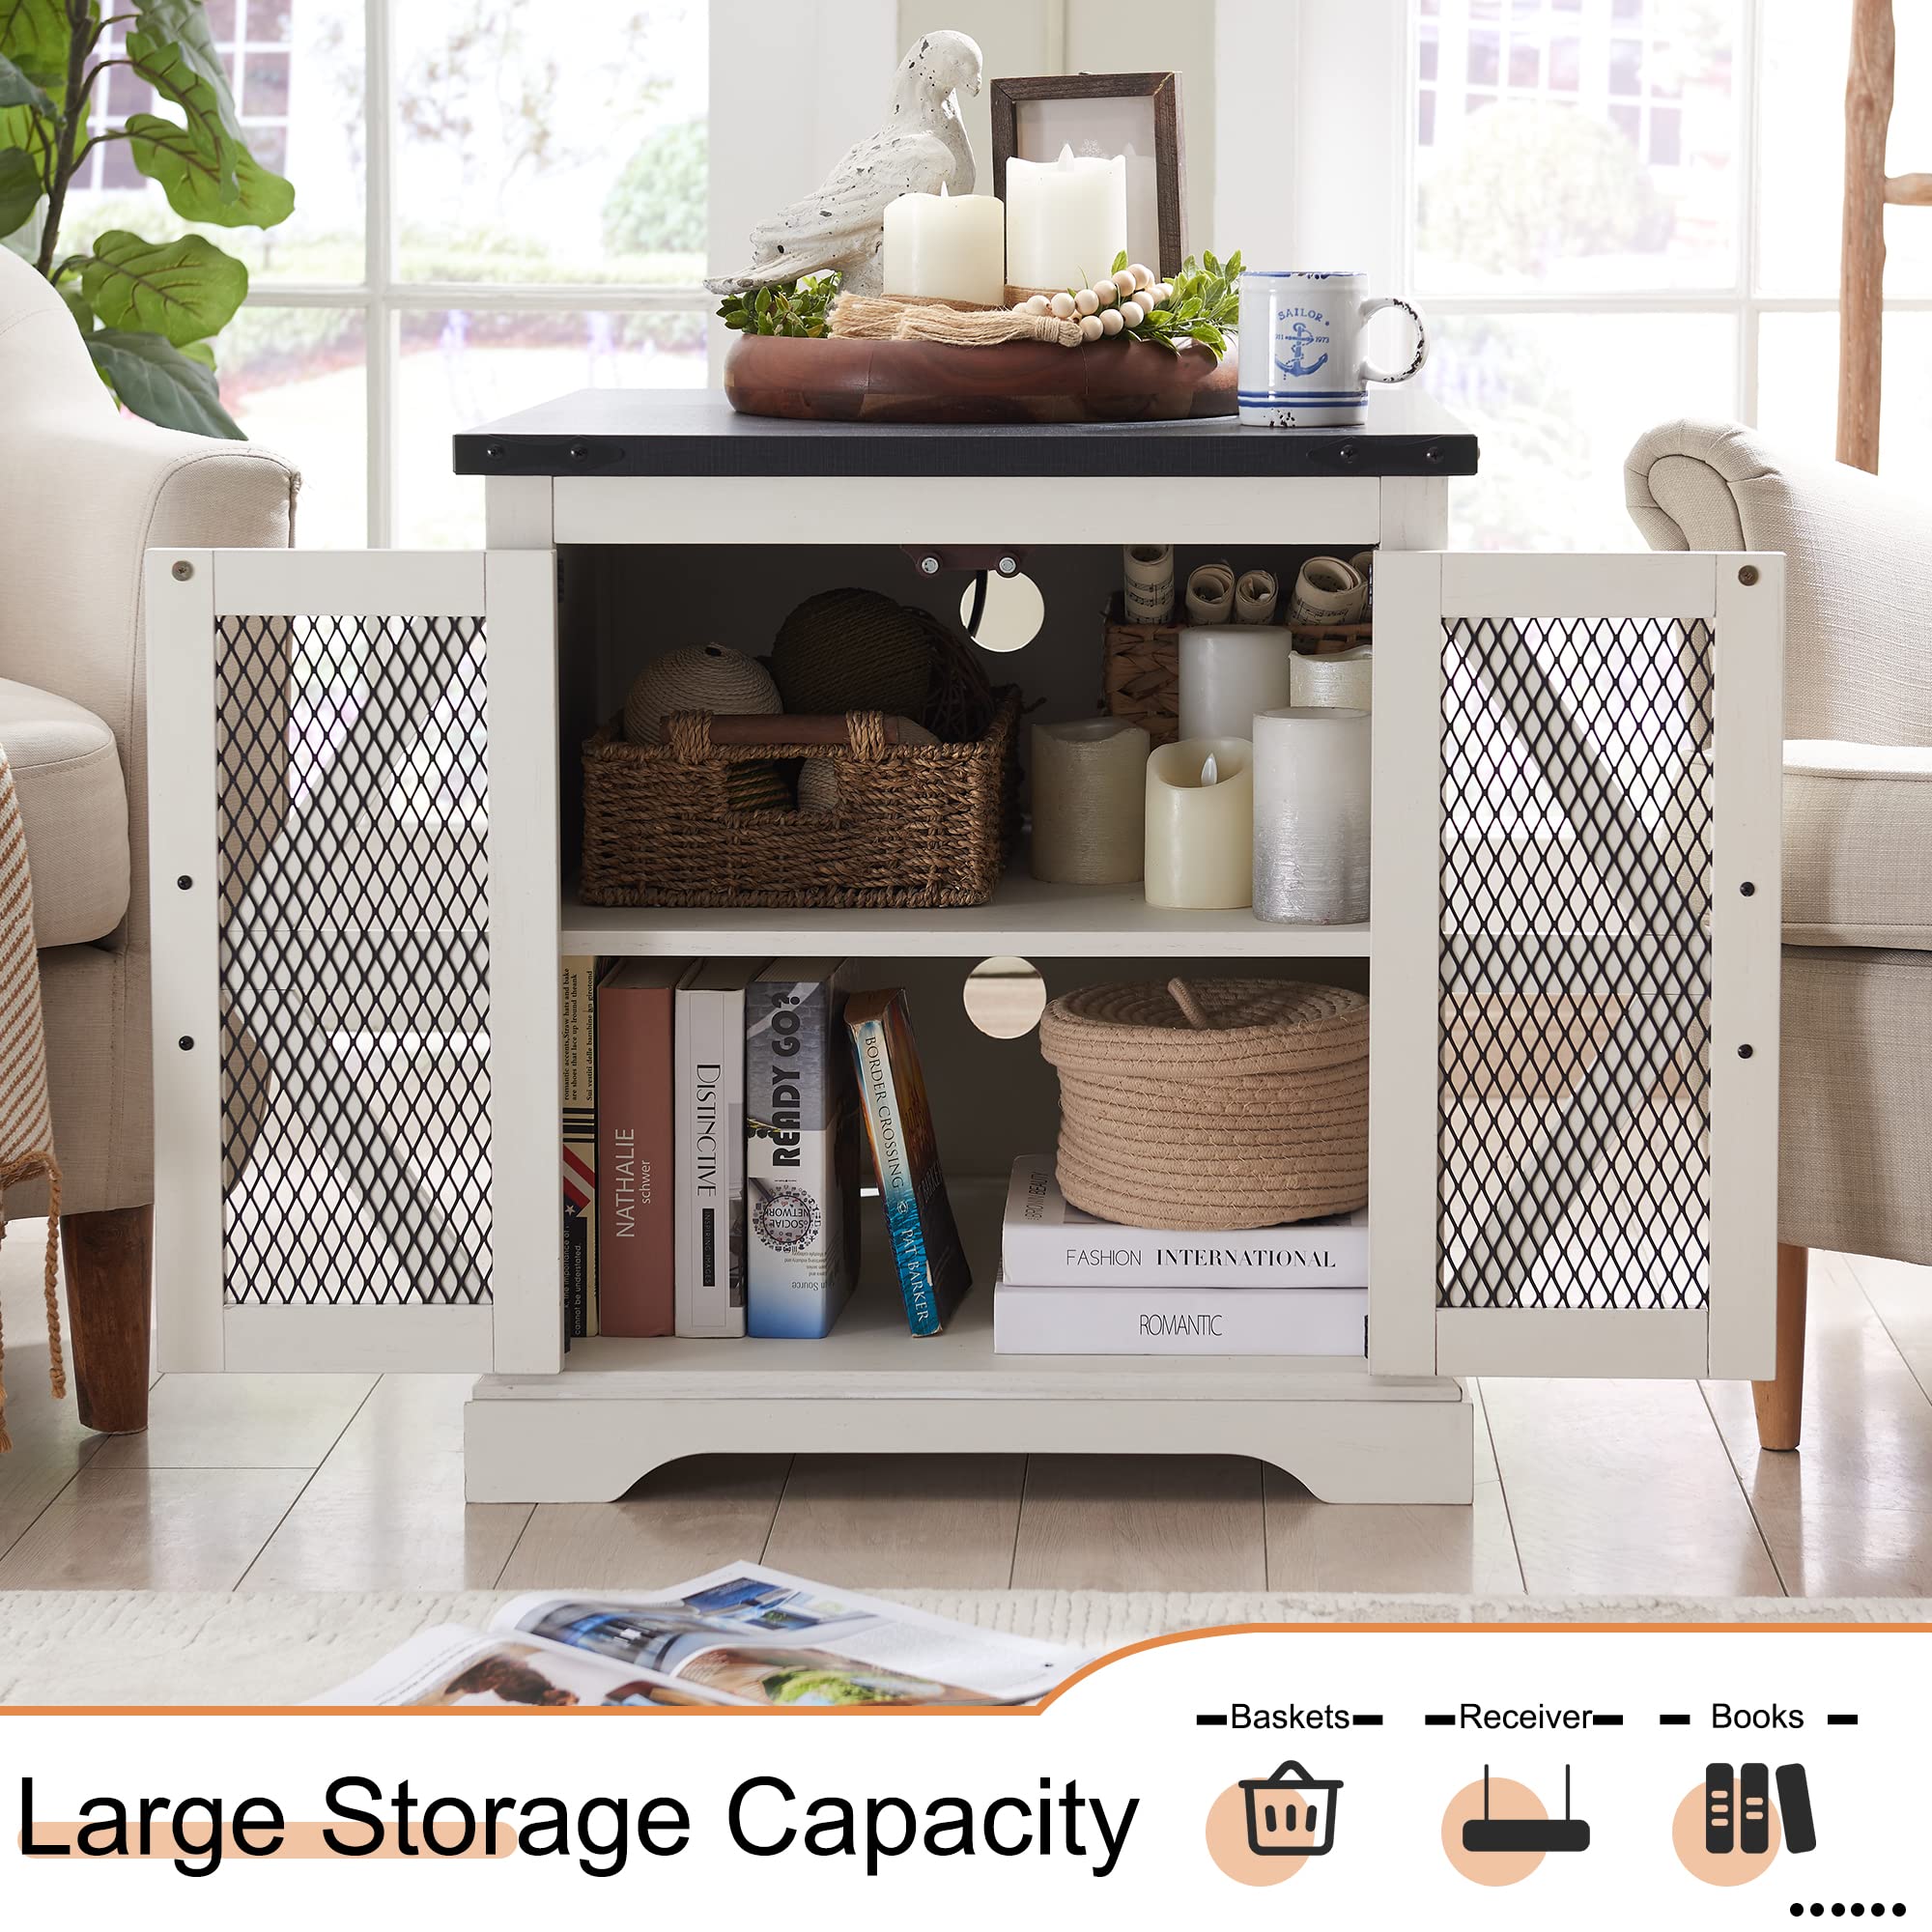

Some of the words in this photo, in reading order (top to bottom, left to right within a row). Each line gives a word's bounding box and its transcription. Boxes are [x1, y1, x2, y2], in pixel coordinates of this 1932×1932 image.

[1277, 307, 1323, 323] SAILOR
[572, 1025, 580, 1035] up
[772, 992, 801, 1057] GO?
[772, 1065, 801, 1167] READY
[865, 1036, 886, 1102] BORDER
[879, 1104, 904, 1188] CROSSING
[696, 1064, 722, 1197] DISTINCTIVE
[616, 1127, 636, 1238] NATHALIE
[639, 1159, 650, 1205] schwer
[764, 1208, 809, 1217] NETWORK
[771, 1219, 804, 1229] SOCIAL
[901, 1229, 918, 1256] PAT
[1065, 1248, 1142, 1266] FASHION
[1156, 1248, 1337, 1268] INTERNATIONAL
[574, 1293, 582, 1305] be
[791, 1281, 819, 1292] Source
[907, 1260, 930, 1322] BARKER
[1139, 1313, 1224, 1337] ROMANTIC
